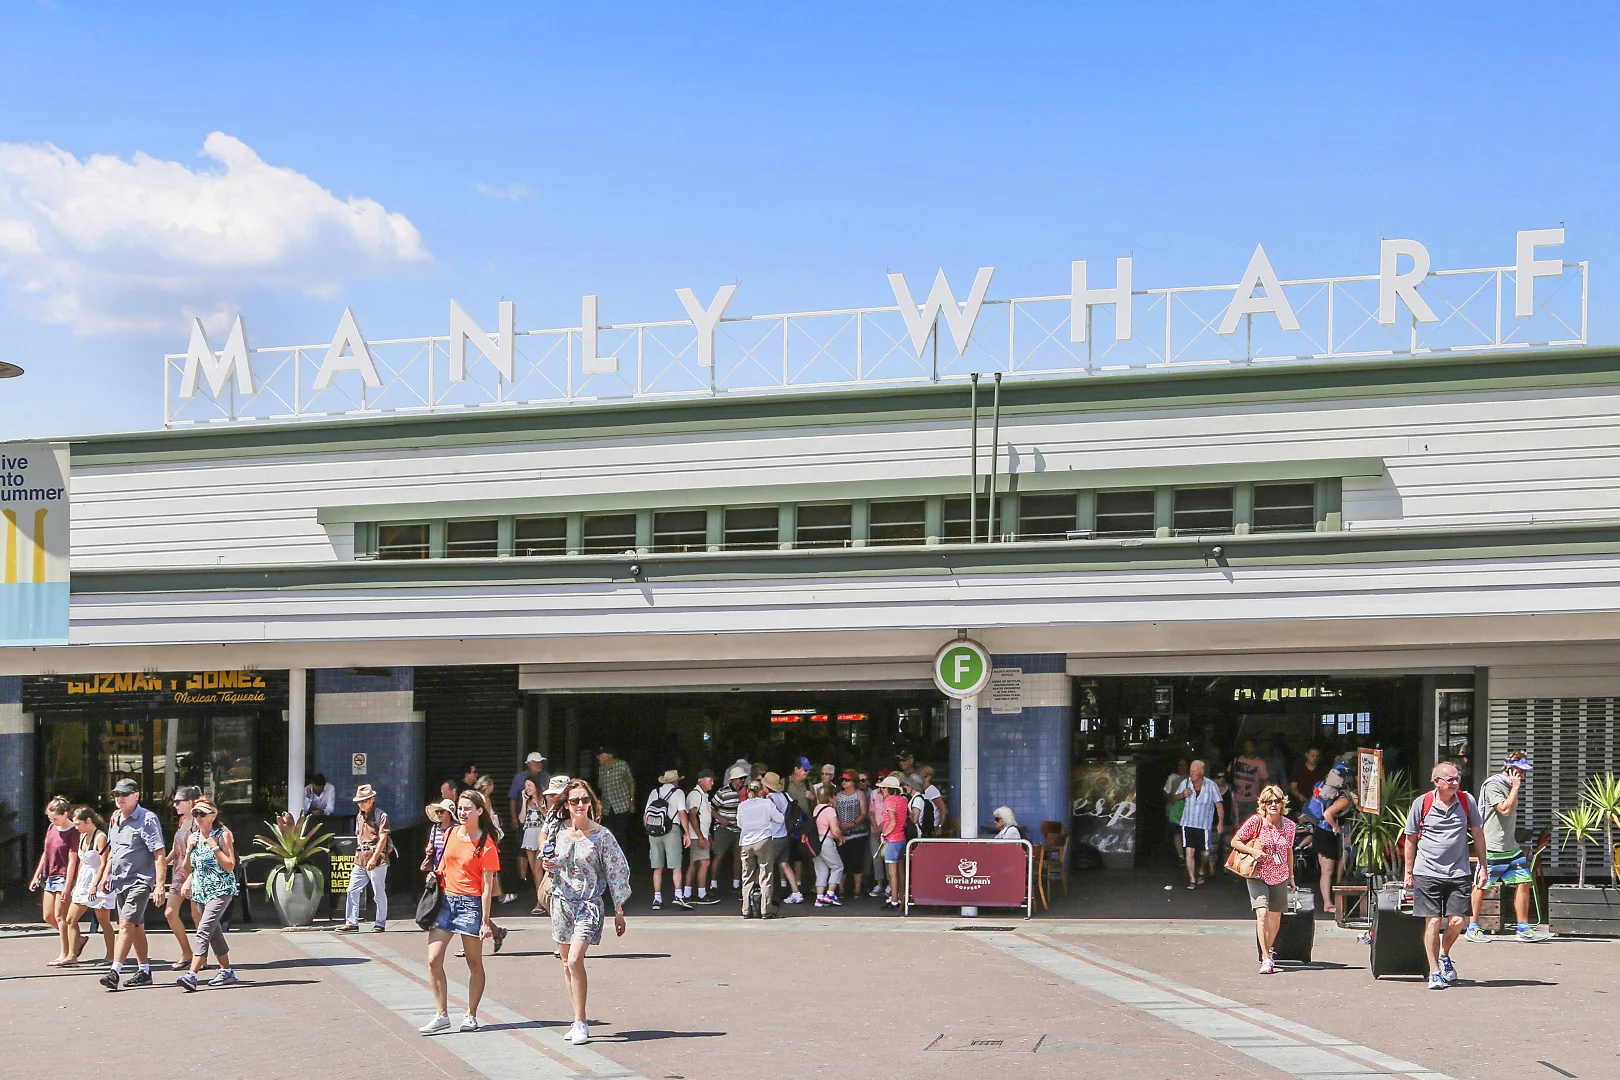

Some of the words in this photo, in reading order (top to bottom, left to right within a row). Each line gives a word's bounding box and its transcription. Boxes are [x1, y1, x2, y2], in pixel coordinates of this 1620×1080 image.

[179, 284, 740, 400] MANLY
[887, 227, 1565, 358] WHARF
[954, 654, 971, 683] F
[174, 692, 217, 704] Mexican
[970, 877, 991, 885] Jean's
